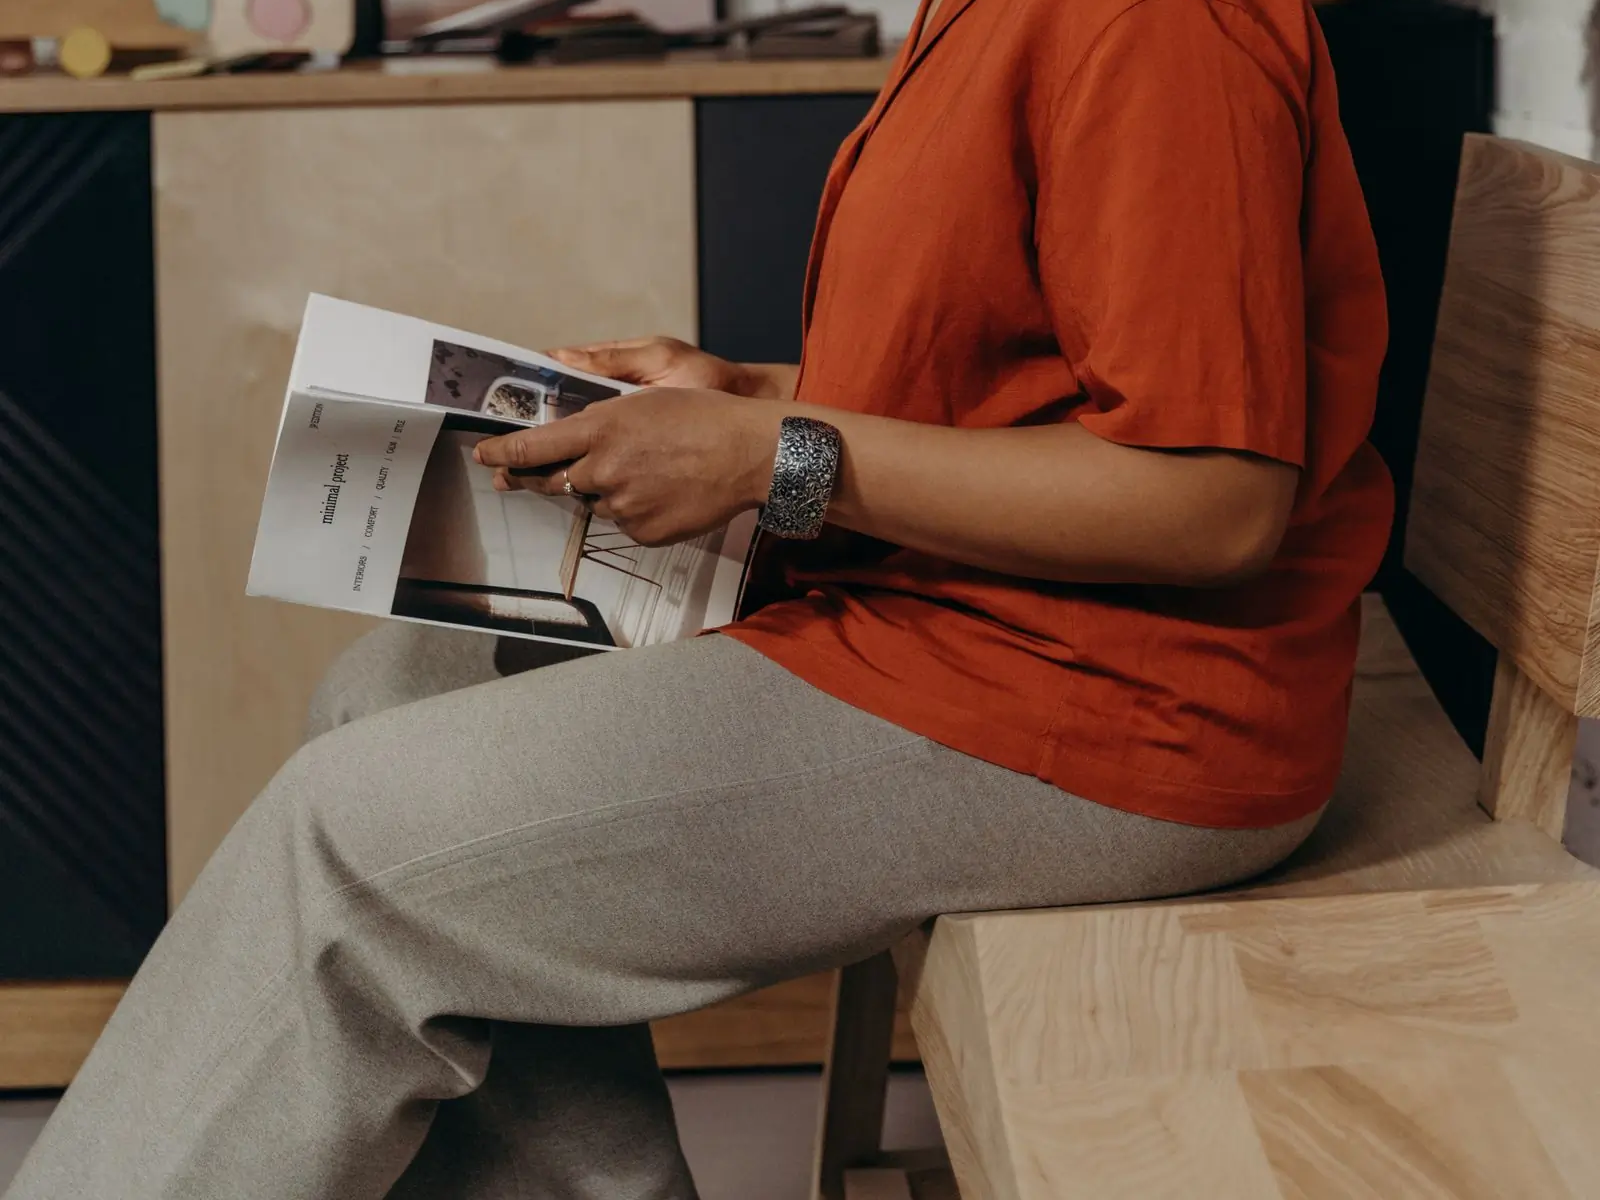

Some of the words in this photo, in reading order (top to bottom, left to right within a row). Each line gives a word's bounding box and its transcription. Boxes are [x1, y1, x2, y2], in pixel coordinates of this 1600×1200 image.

[329, 453, 350, 484] project
[319, 484, 341, 525] minimal
[353, 555, 368, 592] INTERIORS
[364, 505, 380, 538] COMFORT
[375, 465, 389, 491] QUALITY
[393, 419, 406, 434] STYLE
